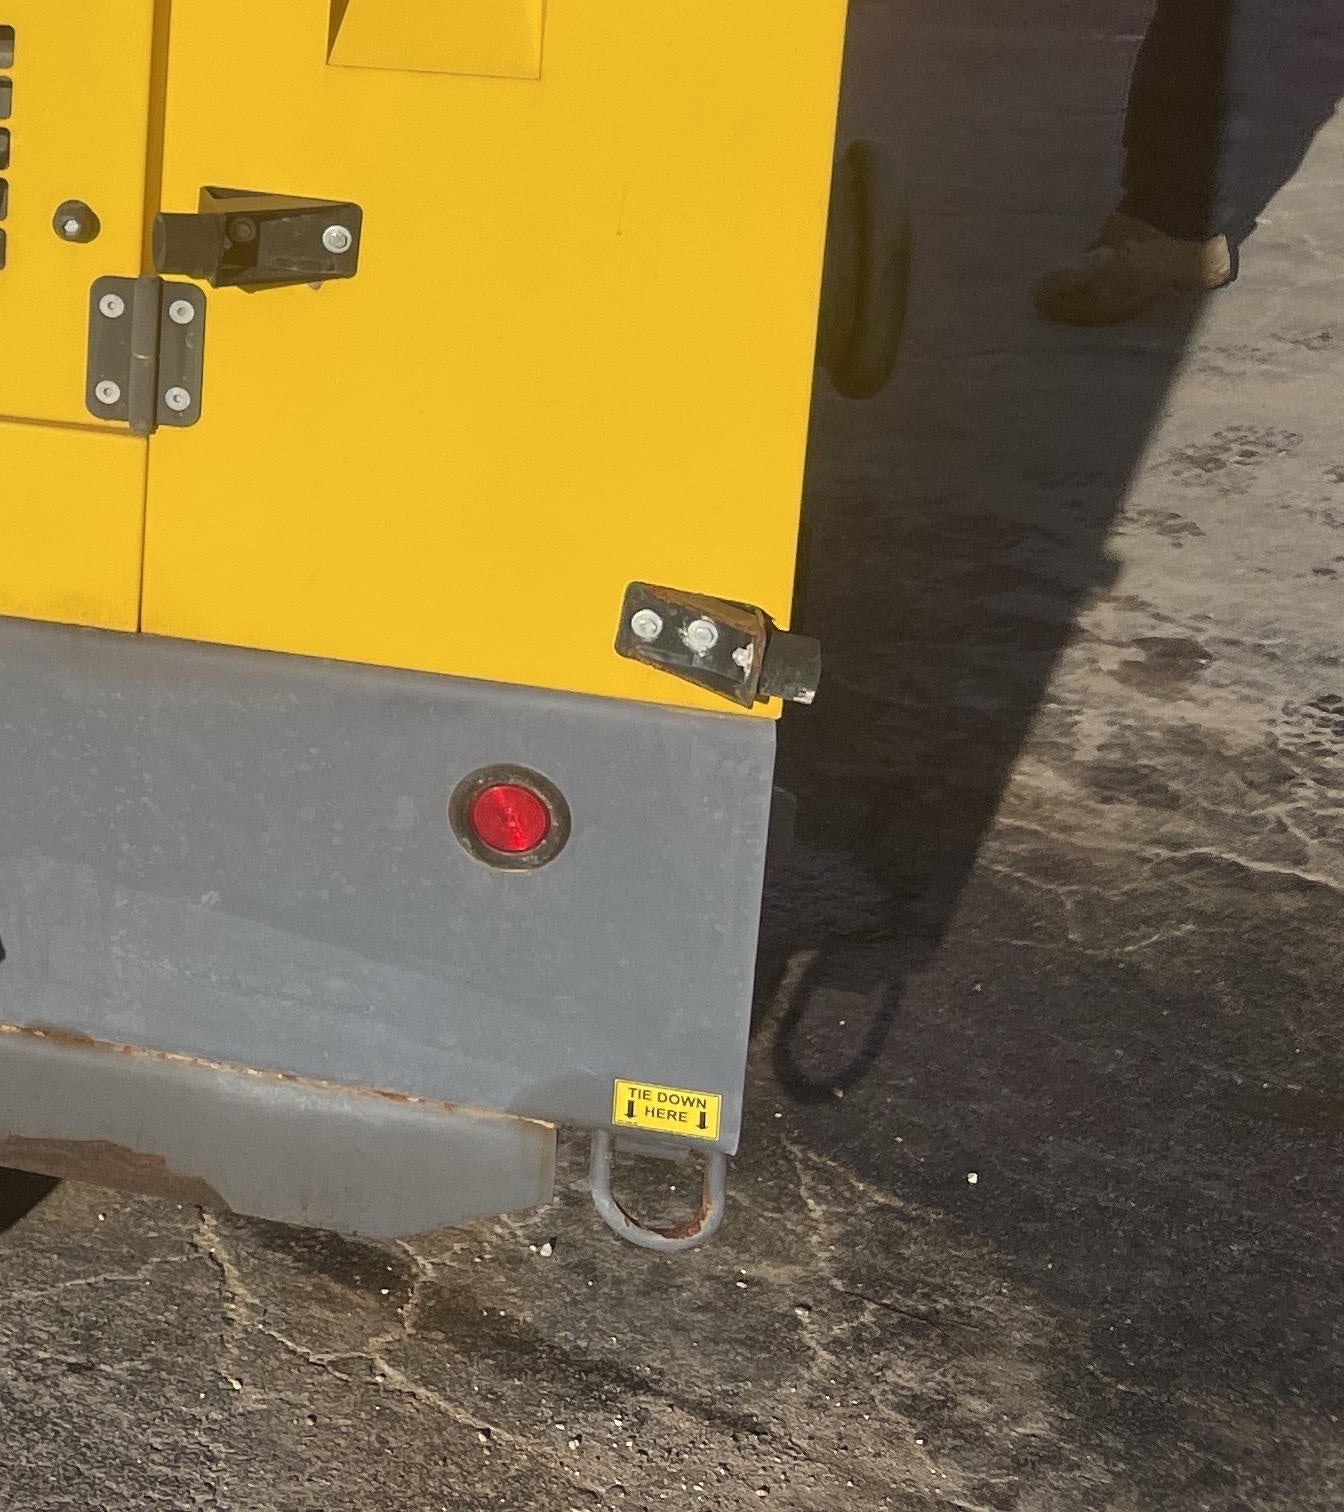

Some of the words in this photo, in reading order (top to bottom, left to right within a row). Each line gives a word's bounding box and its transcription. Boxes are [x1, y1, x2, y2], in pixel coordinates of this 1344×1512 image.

[628, 1088, 652, 1101] TIE
[657, 1092, 707, 1109] DOWN
[645, 1106, 688, 1123] HERE
